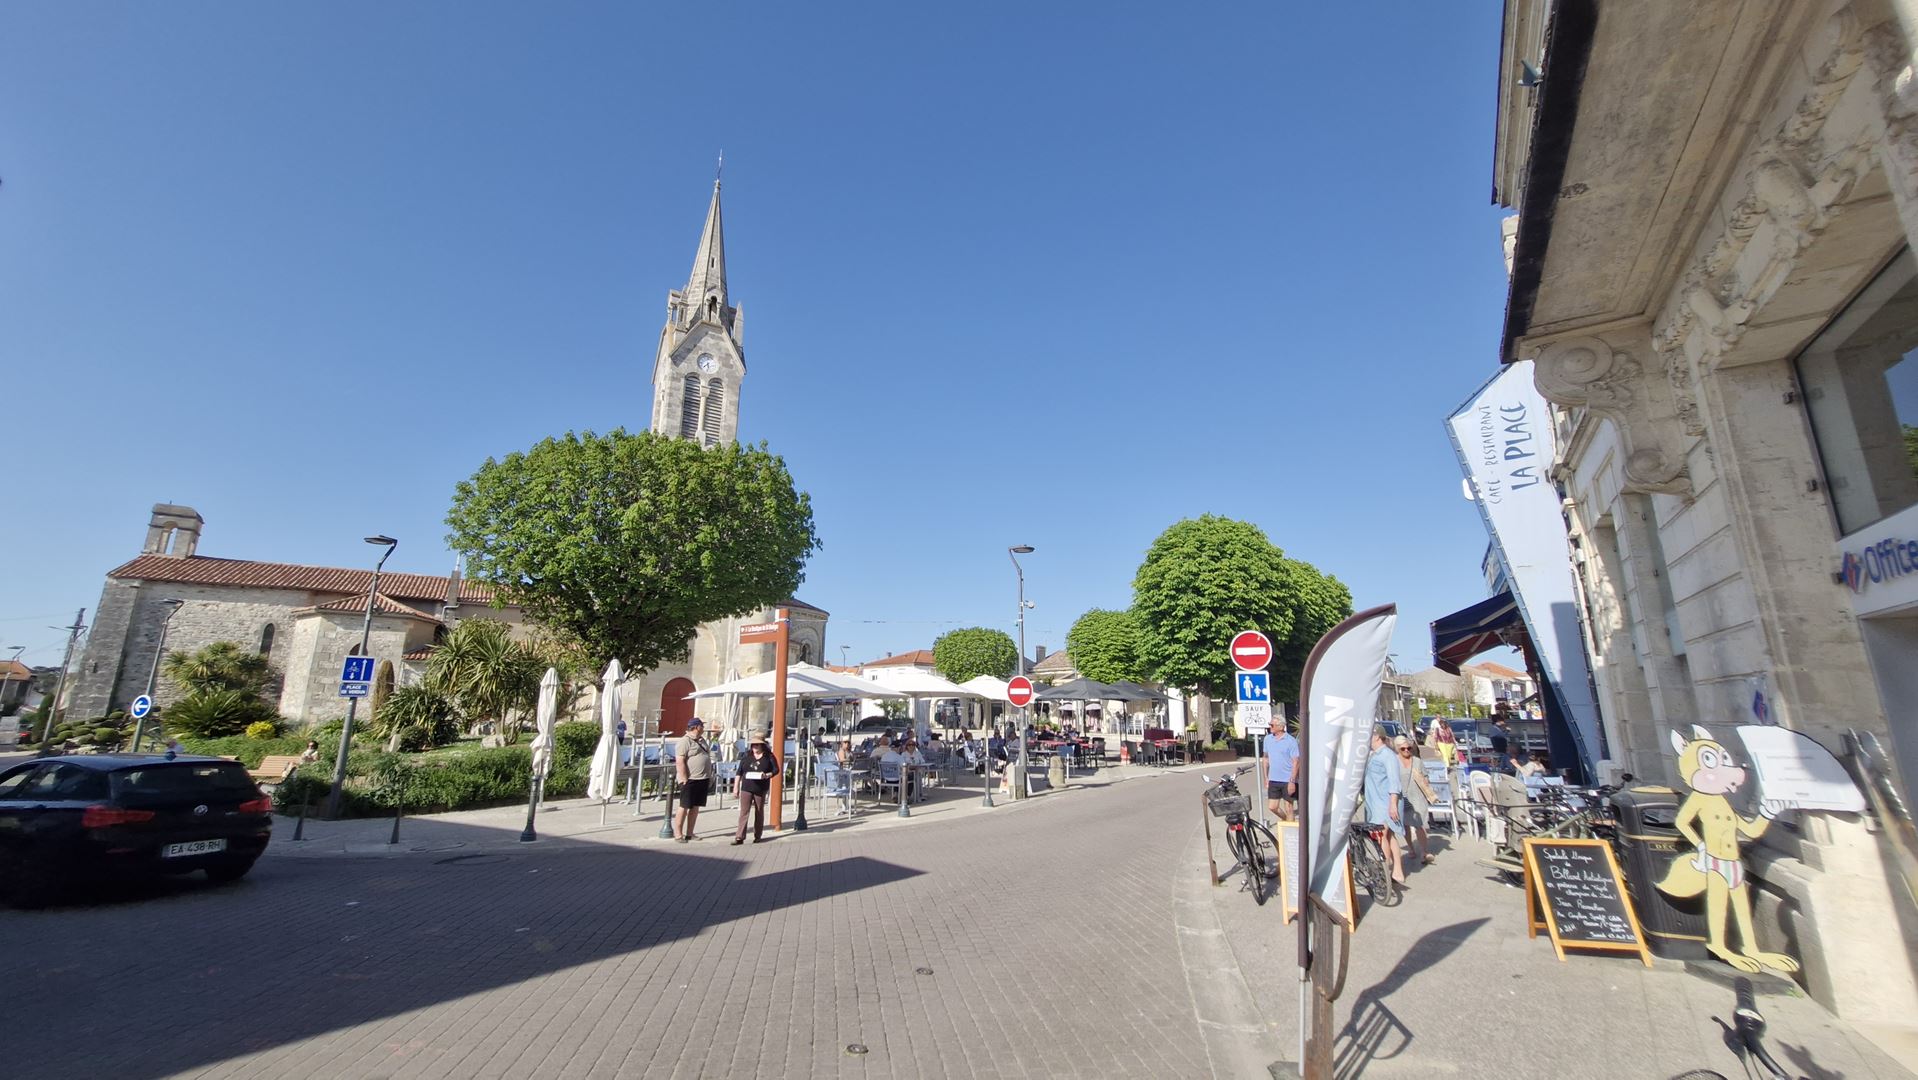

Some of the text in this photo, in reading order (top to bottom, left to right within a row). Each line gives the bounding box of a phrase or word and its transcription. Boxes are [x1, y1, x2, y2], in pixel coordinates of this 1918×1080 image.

[1479, 405, 1499, 466] RESTAURANT
[1499, 401, 1539, 490] LA PLACE
[1864, 538, 1918, 584] Office
[187, 841, 206, 852] 438
[207, 841, 220, 850] RH
